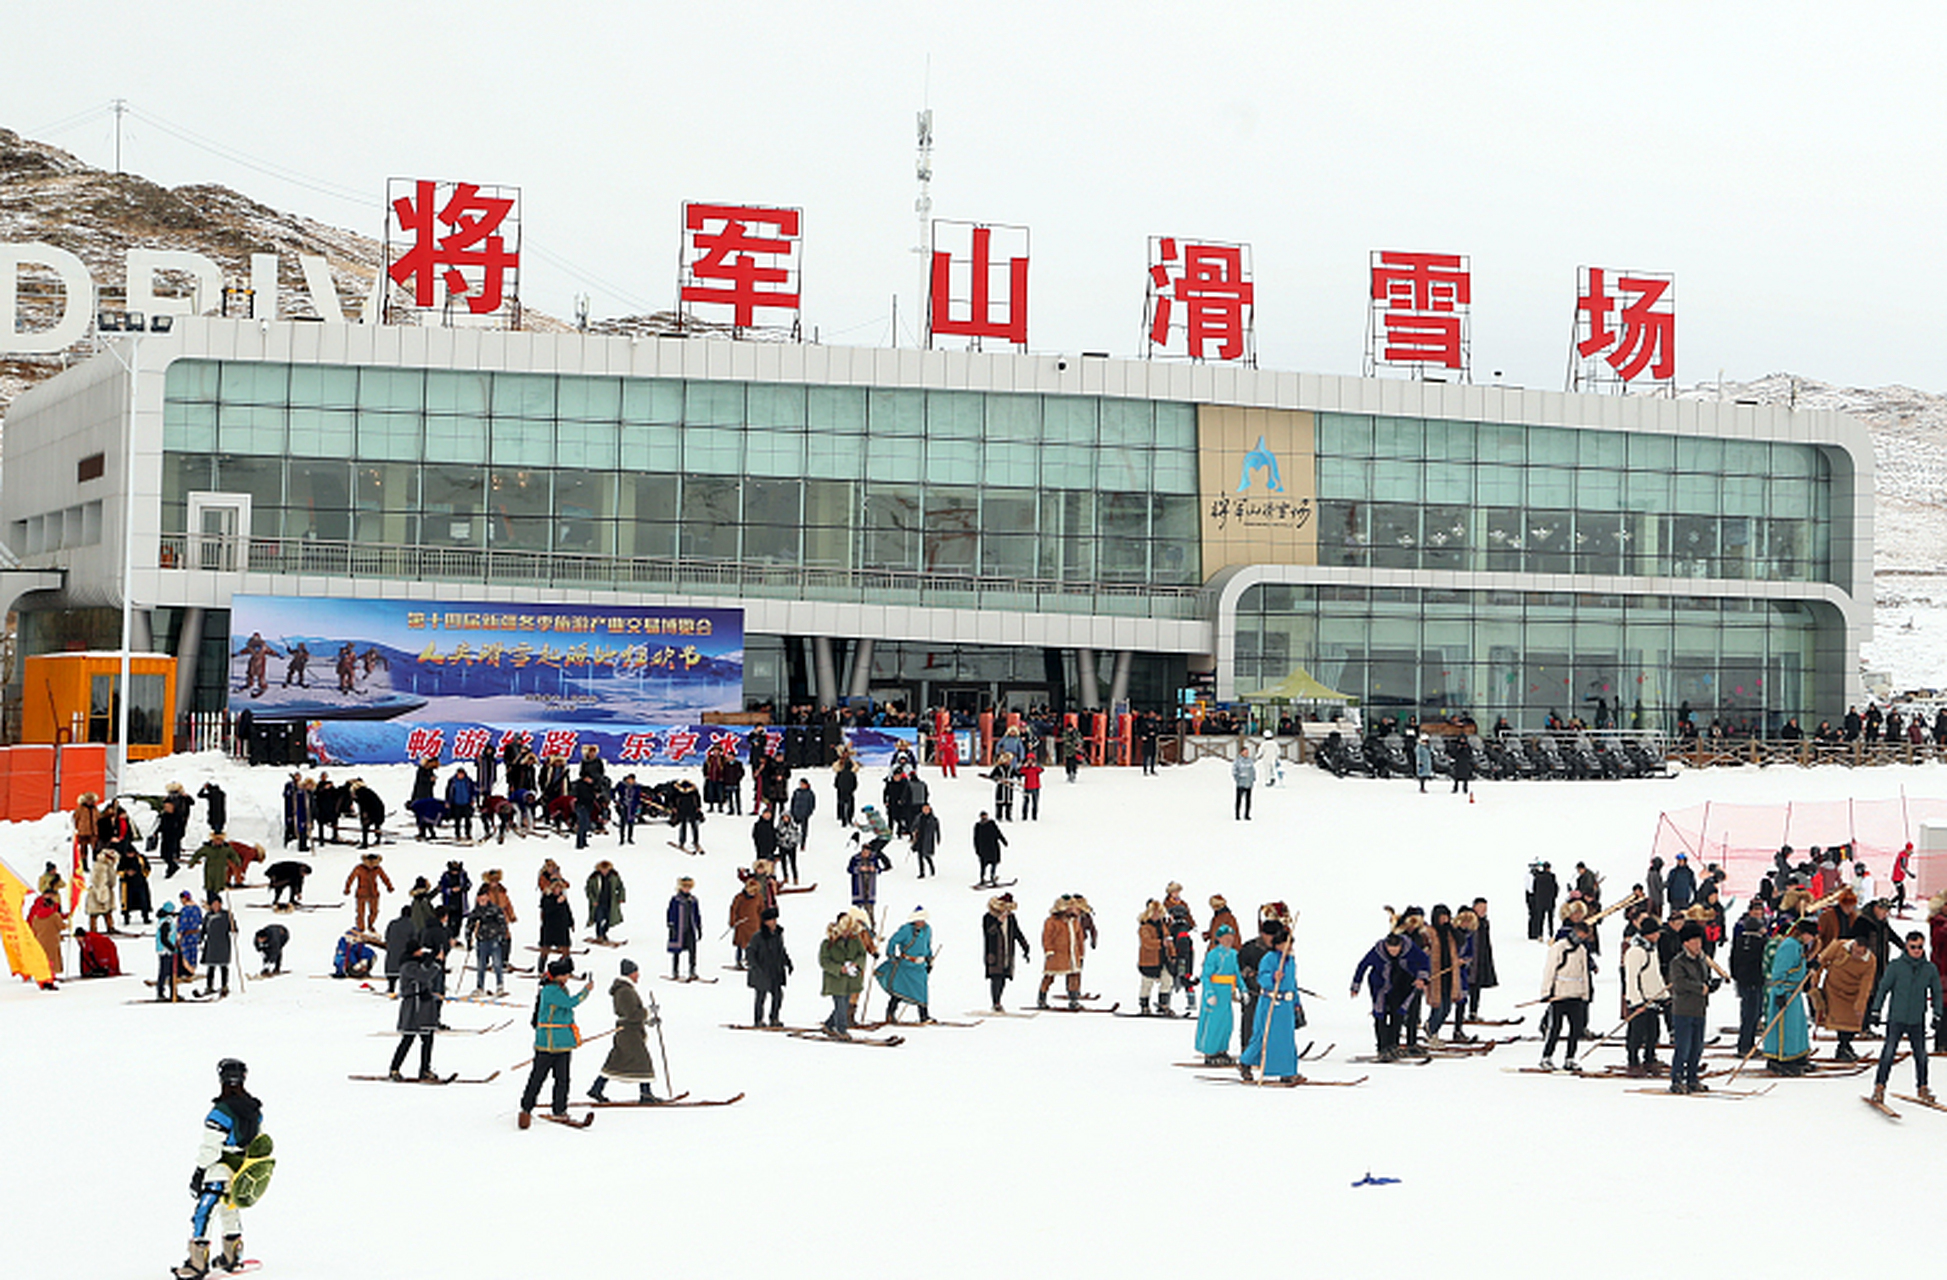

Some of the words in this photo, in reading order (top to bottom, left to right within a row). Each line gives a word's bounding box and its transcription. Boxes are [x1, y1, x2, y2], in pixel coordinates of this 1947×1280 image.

[389, 181, 1674, 382] 将军山滑雪场
